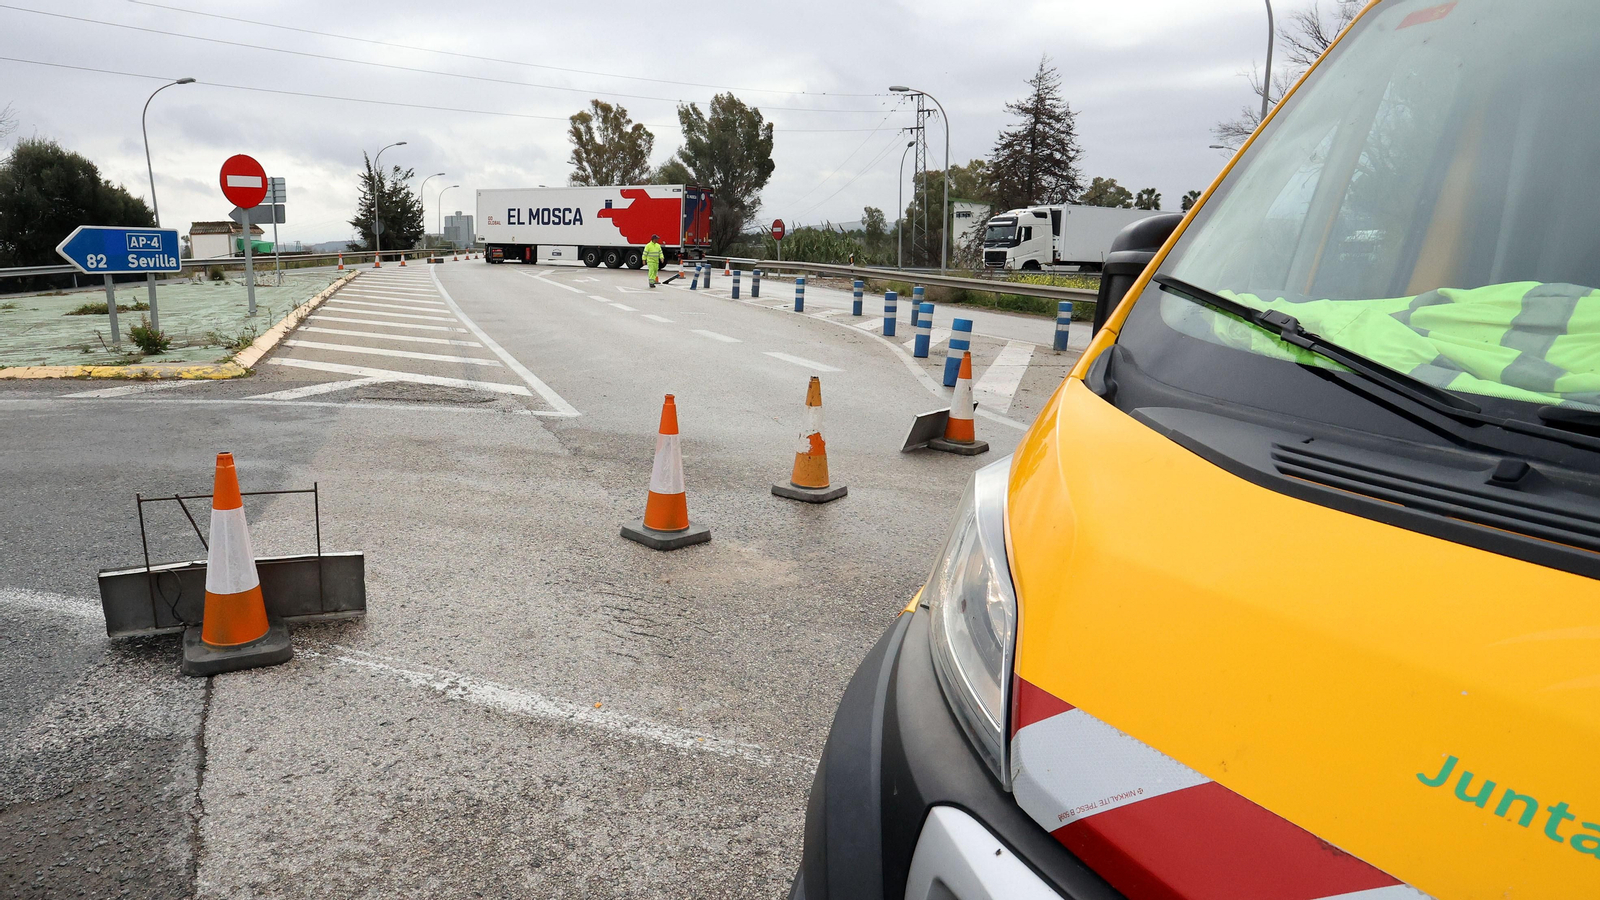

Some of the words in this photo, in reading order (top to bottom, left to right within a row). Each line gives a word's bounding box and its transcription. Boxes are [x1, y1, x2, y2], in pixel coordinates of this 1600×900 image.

[507, 208, 525, 225] EL
[528, 207, 583, 226] MOSCA
[130, 236, 159, 248] AP-4
[86, 253, 108, 269] 82
[127, 253, 177, 268] Sevilla
[1099, 789, 1137, 807] NIKKALITE
[1069, 808, 1076, 816] B
[1416, 755, 1600, 860] Junta
